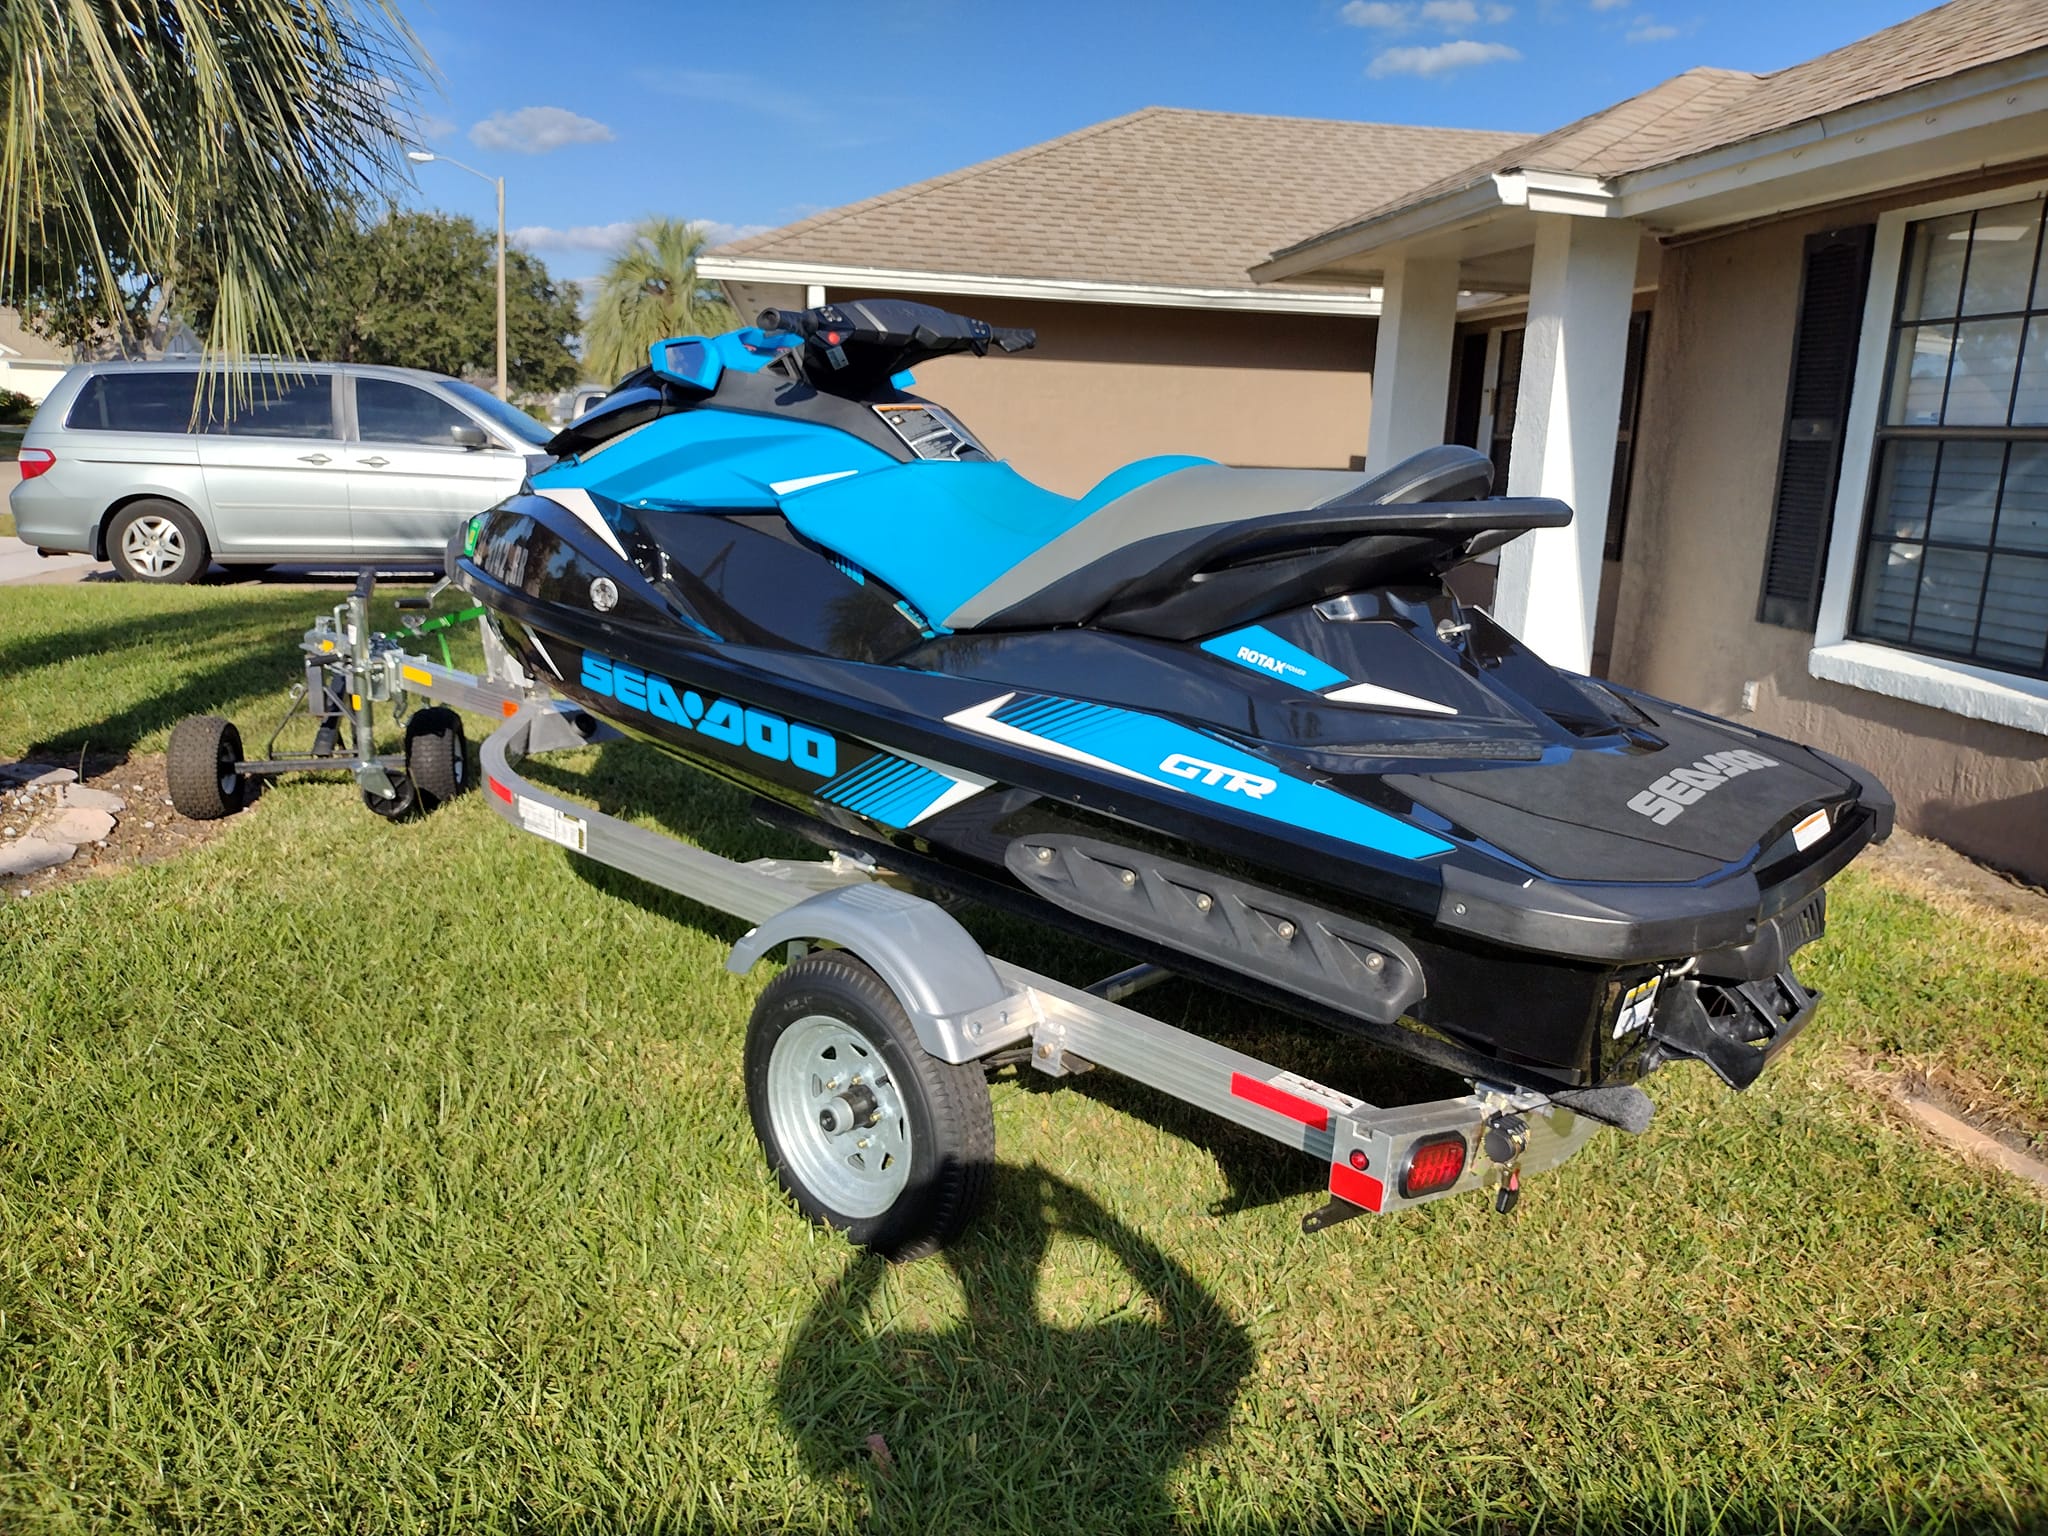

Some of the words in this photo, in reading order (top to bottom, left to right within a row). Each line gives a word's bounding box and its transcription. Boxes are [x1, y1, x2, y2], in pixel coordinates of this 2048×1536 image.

[1237, 646, 1286, 674] ROTAX
[1285, 663, 1307, 677] POWER
[1159, 753, 1277, 800] GTR
